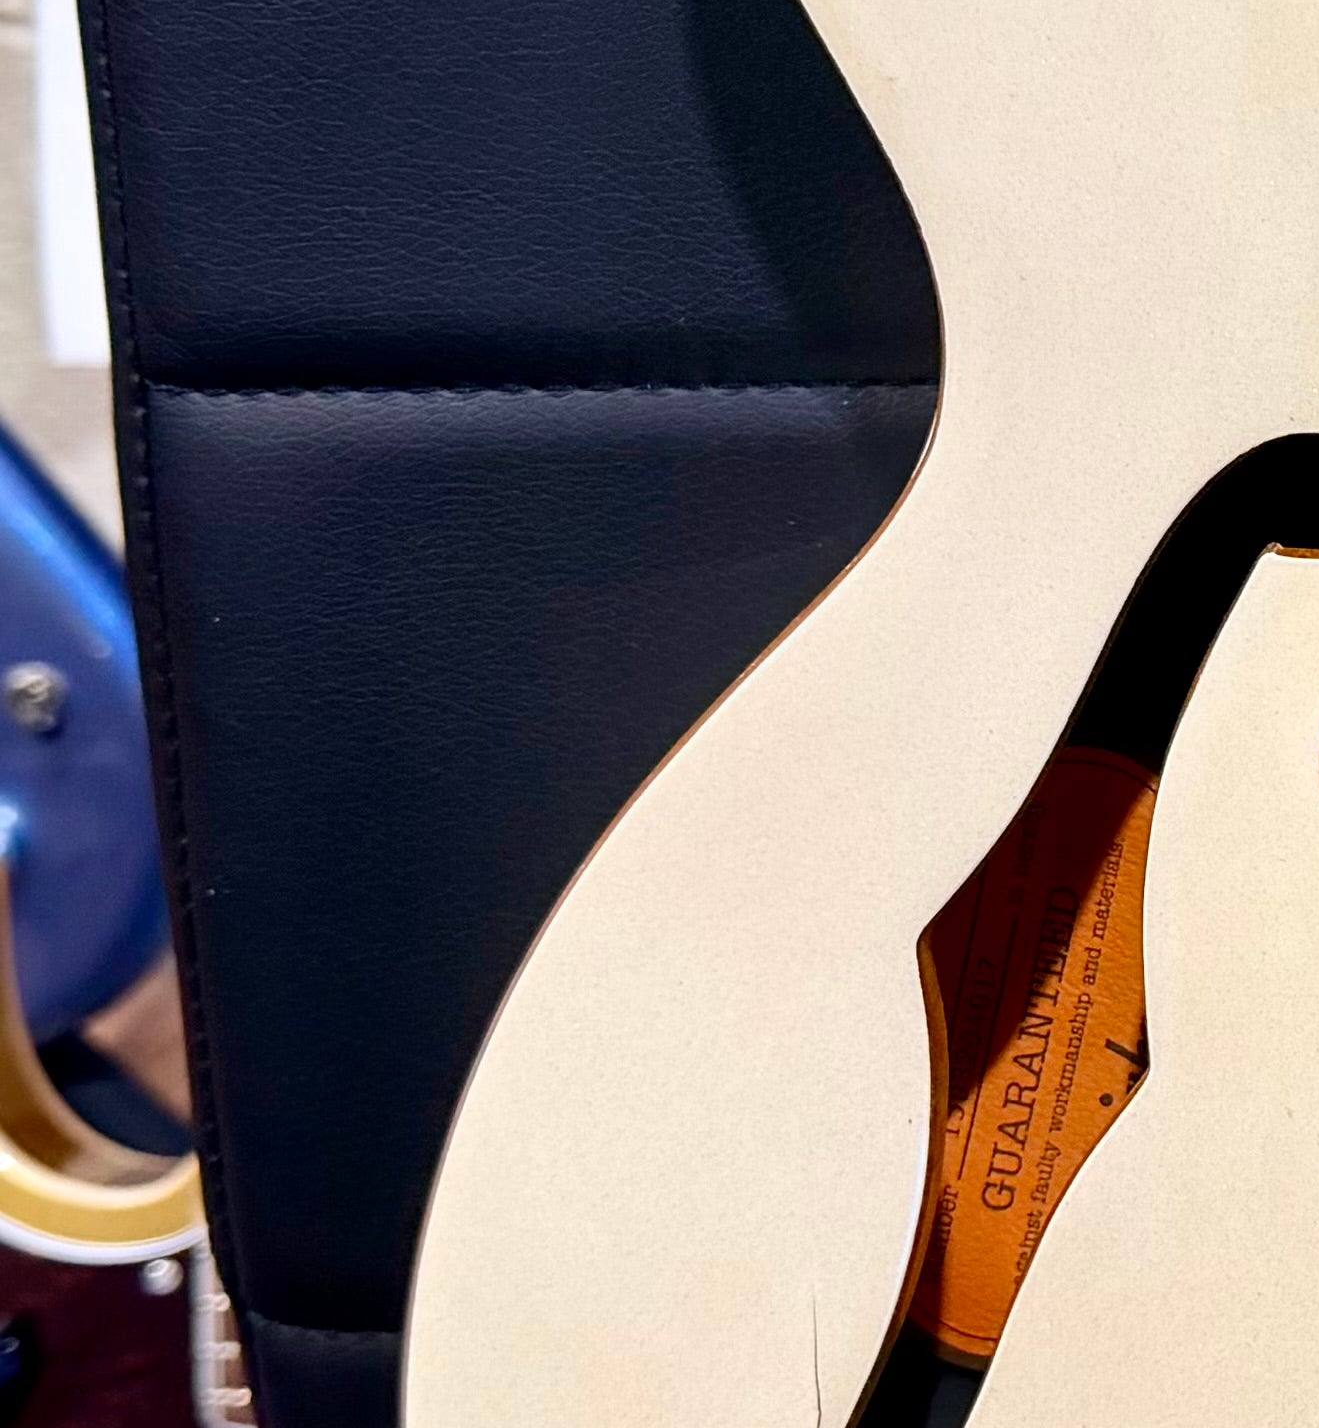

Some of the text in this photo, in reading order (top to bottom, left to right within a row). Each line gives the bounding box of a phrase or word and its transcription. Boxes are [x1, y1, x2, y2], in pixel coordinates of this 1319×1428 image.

[980, 886, 1080, 1212] GUARANTEED
[1030, 1139, 1062, 1204] faulty
[1048, 991, 1095, 1134] workmanship
[1082, 946, 1103, 986] and
